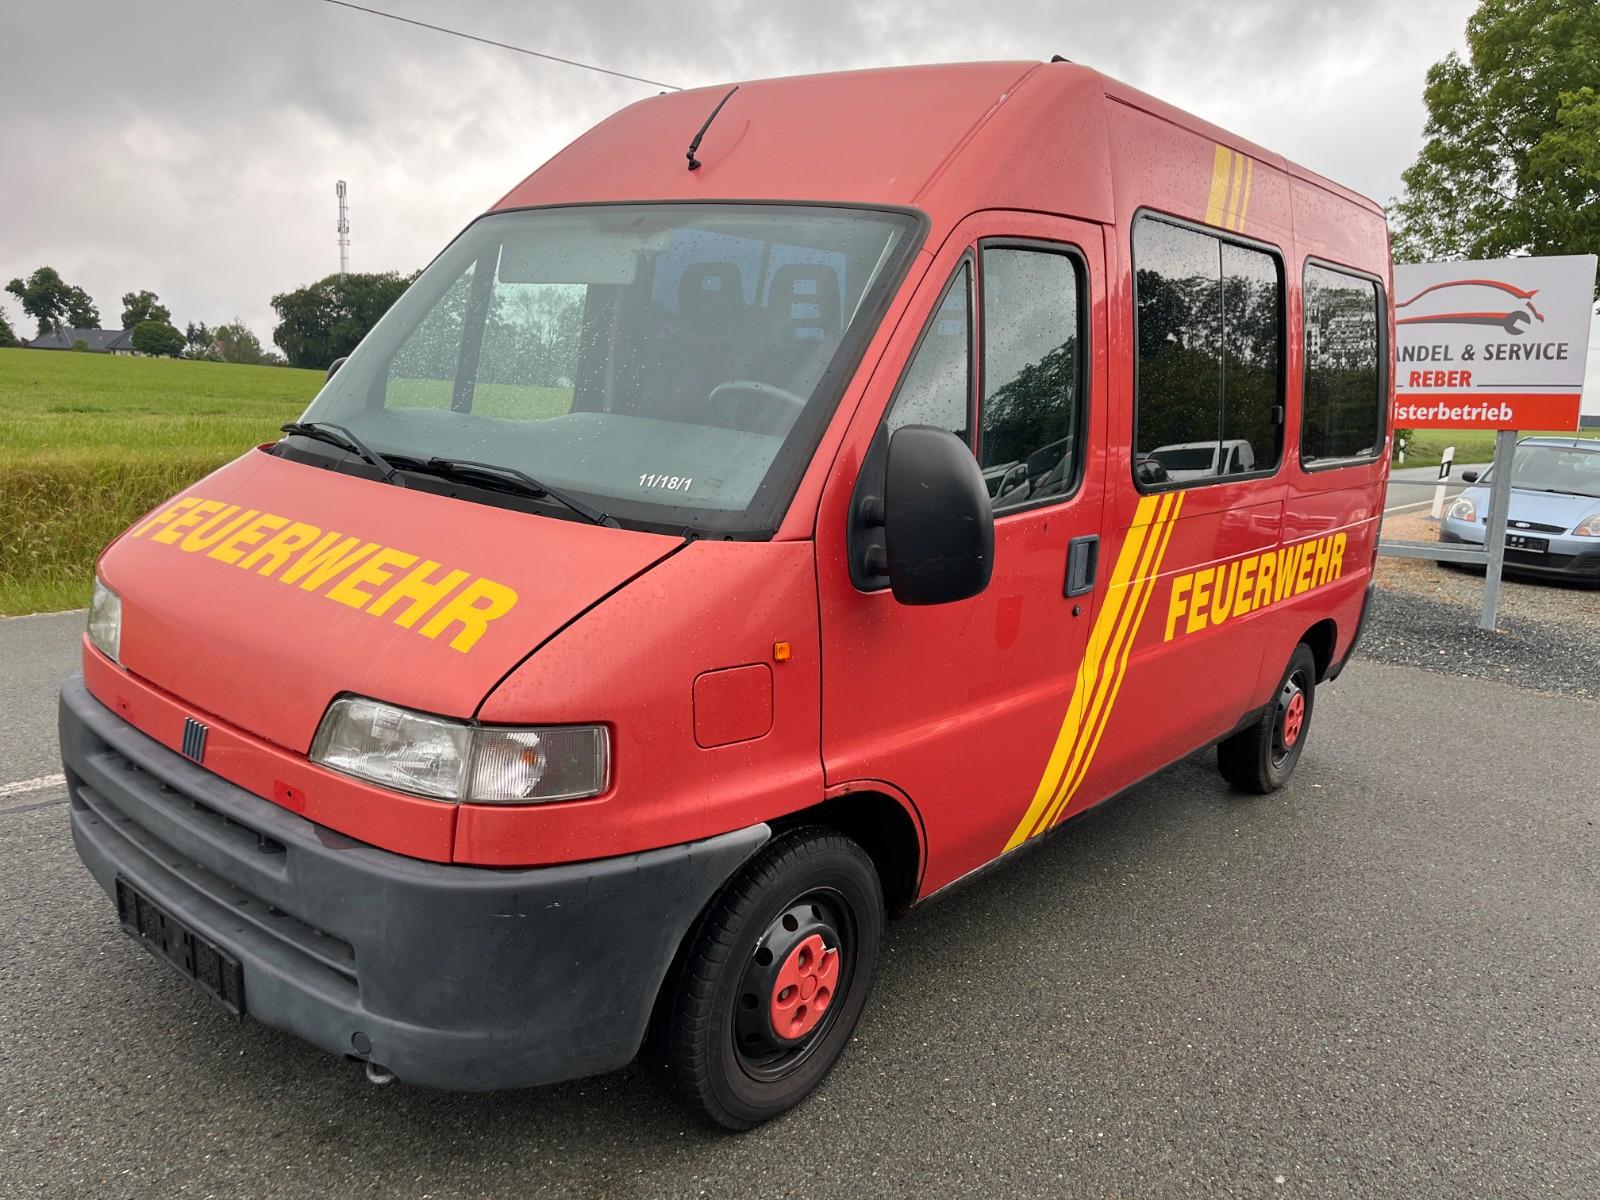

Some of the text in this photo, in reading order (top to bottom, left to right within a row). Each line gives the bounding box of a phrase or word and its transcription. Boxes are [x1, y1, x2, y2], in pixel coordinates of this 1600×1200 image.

[1461, 344, 1475, 361] &
[1483, 342, 1569, 361] SERVICE
[1409, 370, 1472, 388] REBER
[639, 473, 693, 492] 11/18/1
[131, 497, 519, 654] FEUERWEHR
[1164, 532, 1347, 642] FEUERWEHR
